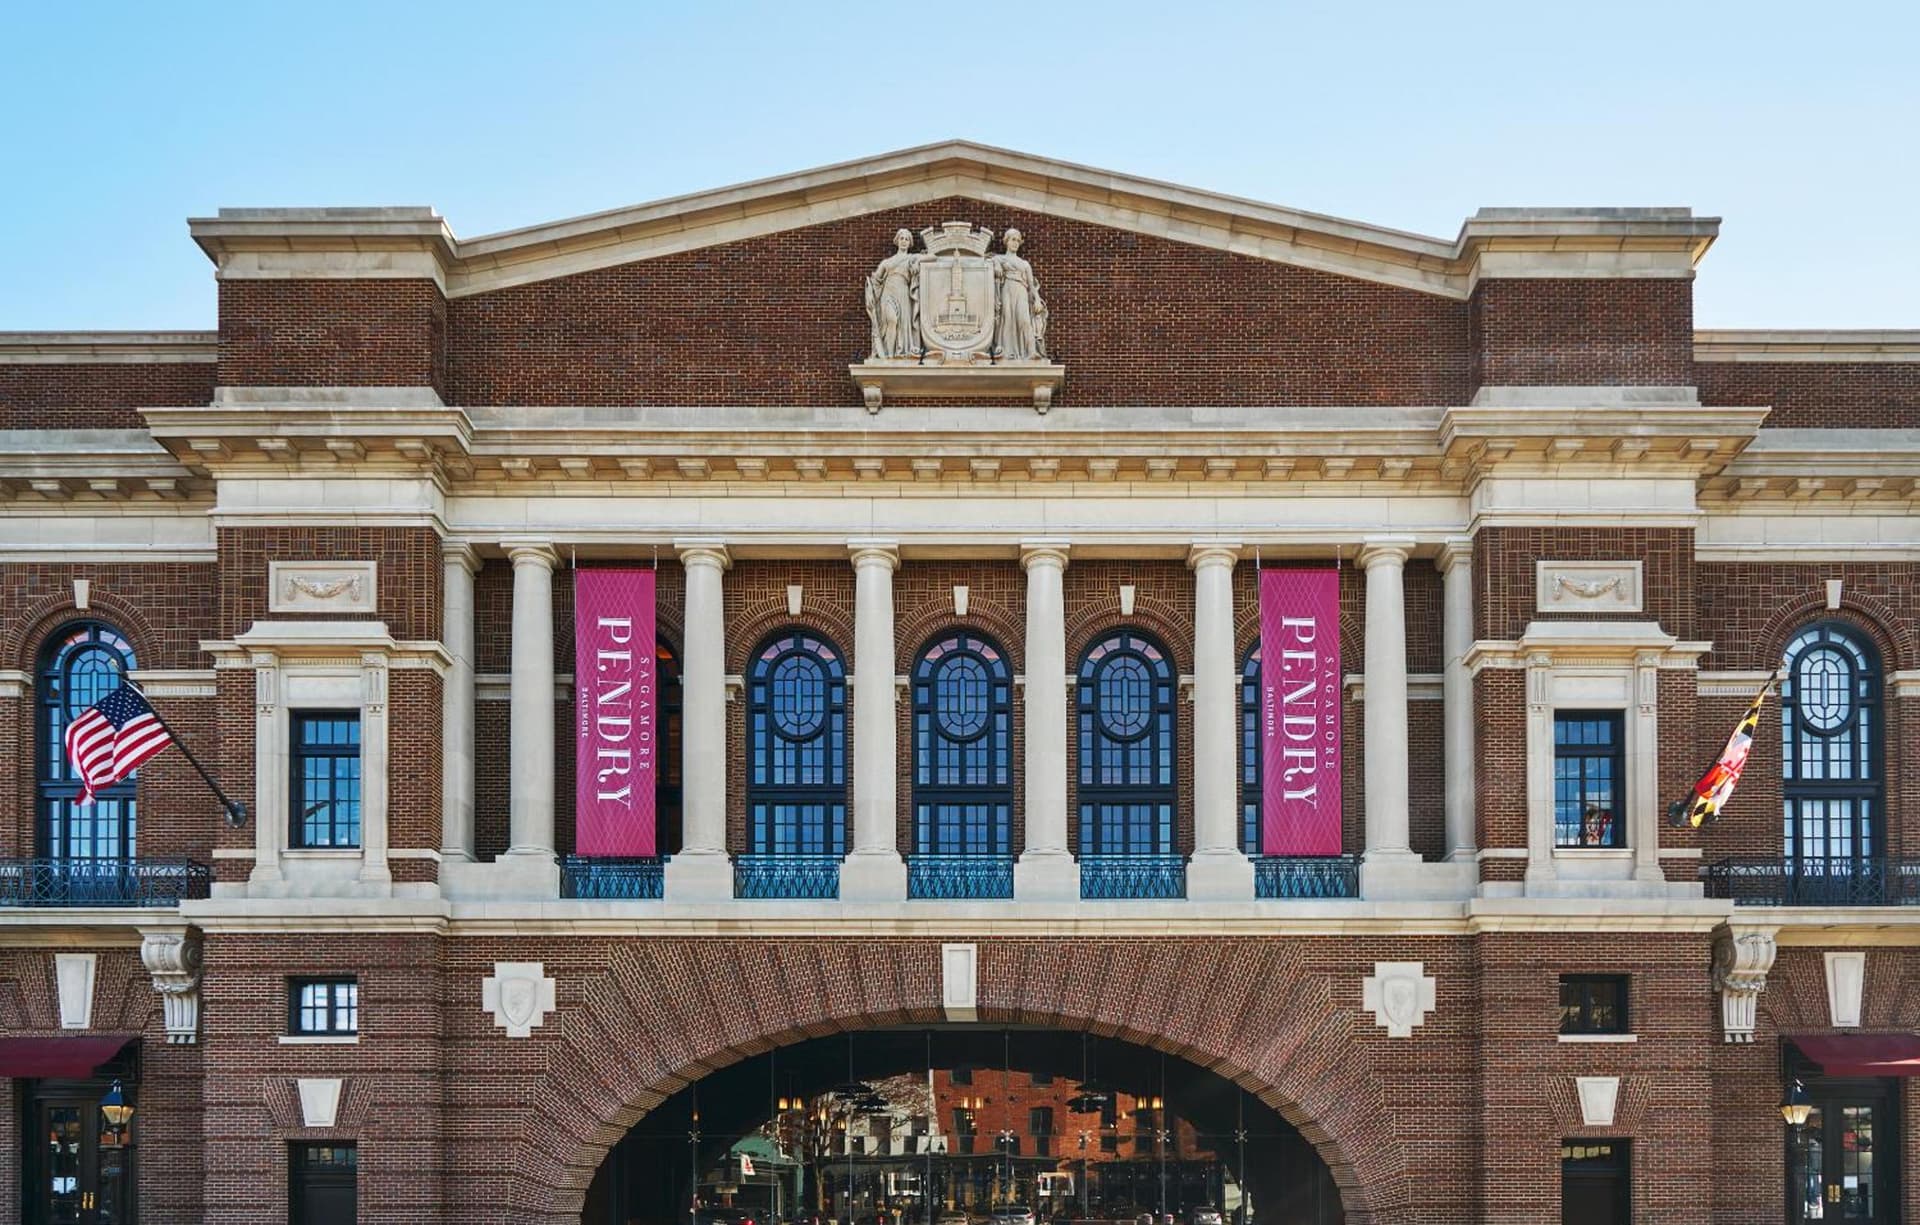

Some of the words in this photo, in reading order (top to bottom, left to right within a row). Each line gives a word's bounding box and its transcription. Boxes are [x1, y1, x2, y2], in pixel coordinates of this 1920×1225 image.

[581, 687, 589, 738] BALTIMORE
[598, 616, 632, 810] PENDRY
[640, 657, 650, 769] SAGAMORE
[1266, 686, 1275, 737] BALTIMORE
[1282, 616, 1317, 810] PENDRY
[1325, 657, 1335, 769] SAGAMORE
